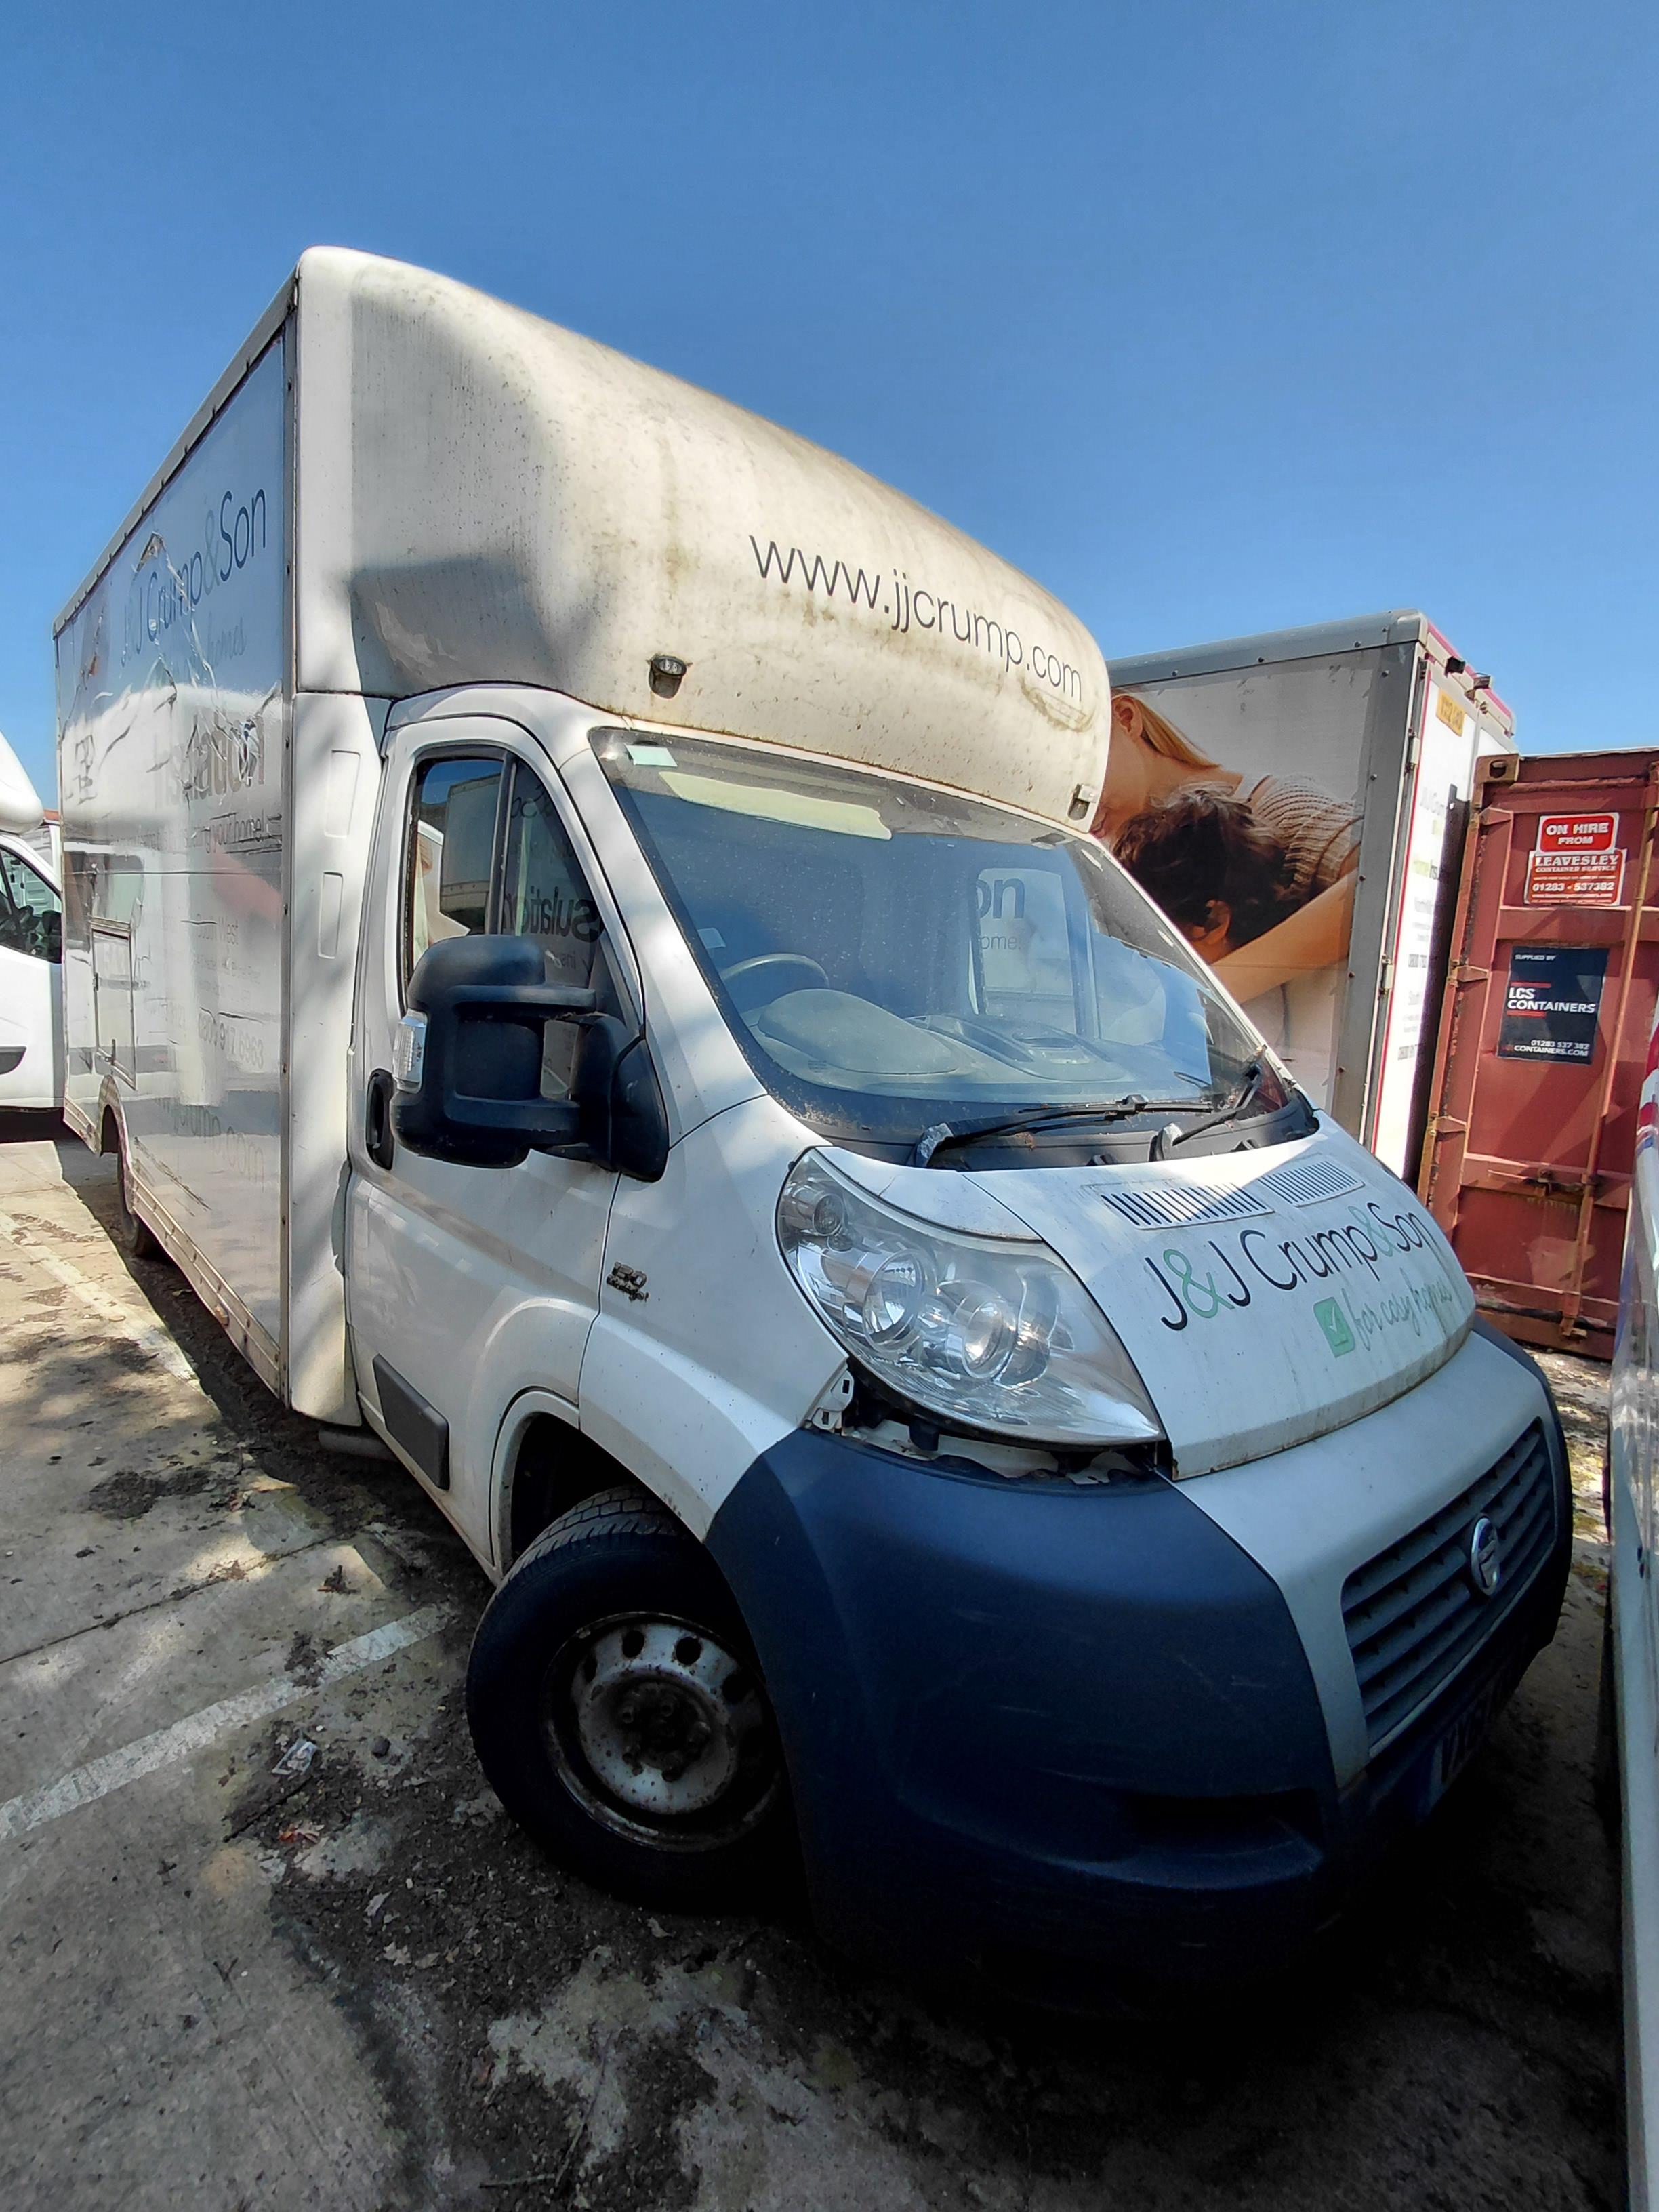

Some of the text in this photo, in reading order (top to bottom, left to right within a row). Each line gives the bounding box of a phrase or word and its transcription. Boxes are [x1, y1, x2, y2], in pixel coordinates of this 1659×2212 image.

[749, 535, 1083, 702] www.jjcrump.com
[1545, 823, 1609, 835] ON HIRE
[1557, 836, 1593, 845] FROM
[1535, 855, 1618, 866] LEAVESLEY
[1532, 883, 1565, 892] 01283
[1573, 882, 1614, 891] 537382
[1509, 987, 1536, 999] LCS
[1507, 1000, 1597, 1014] CONTAINERS
[1240, 1202, 1437, 1290] Crump&Son
